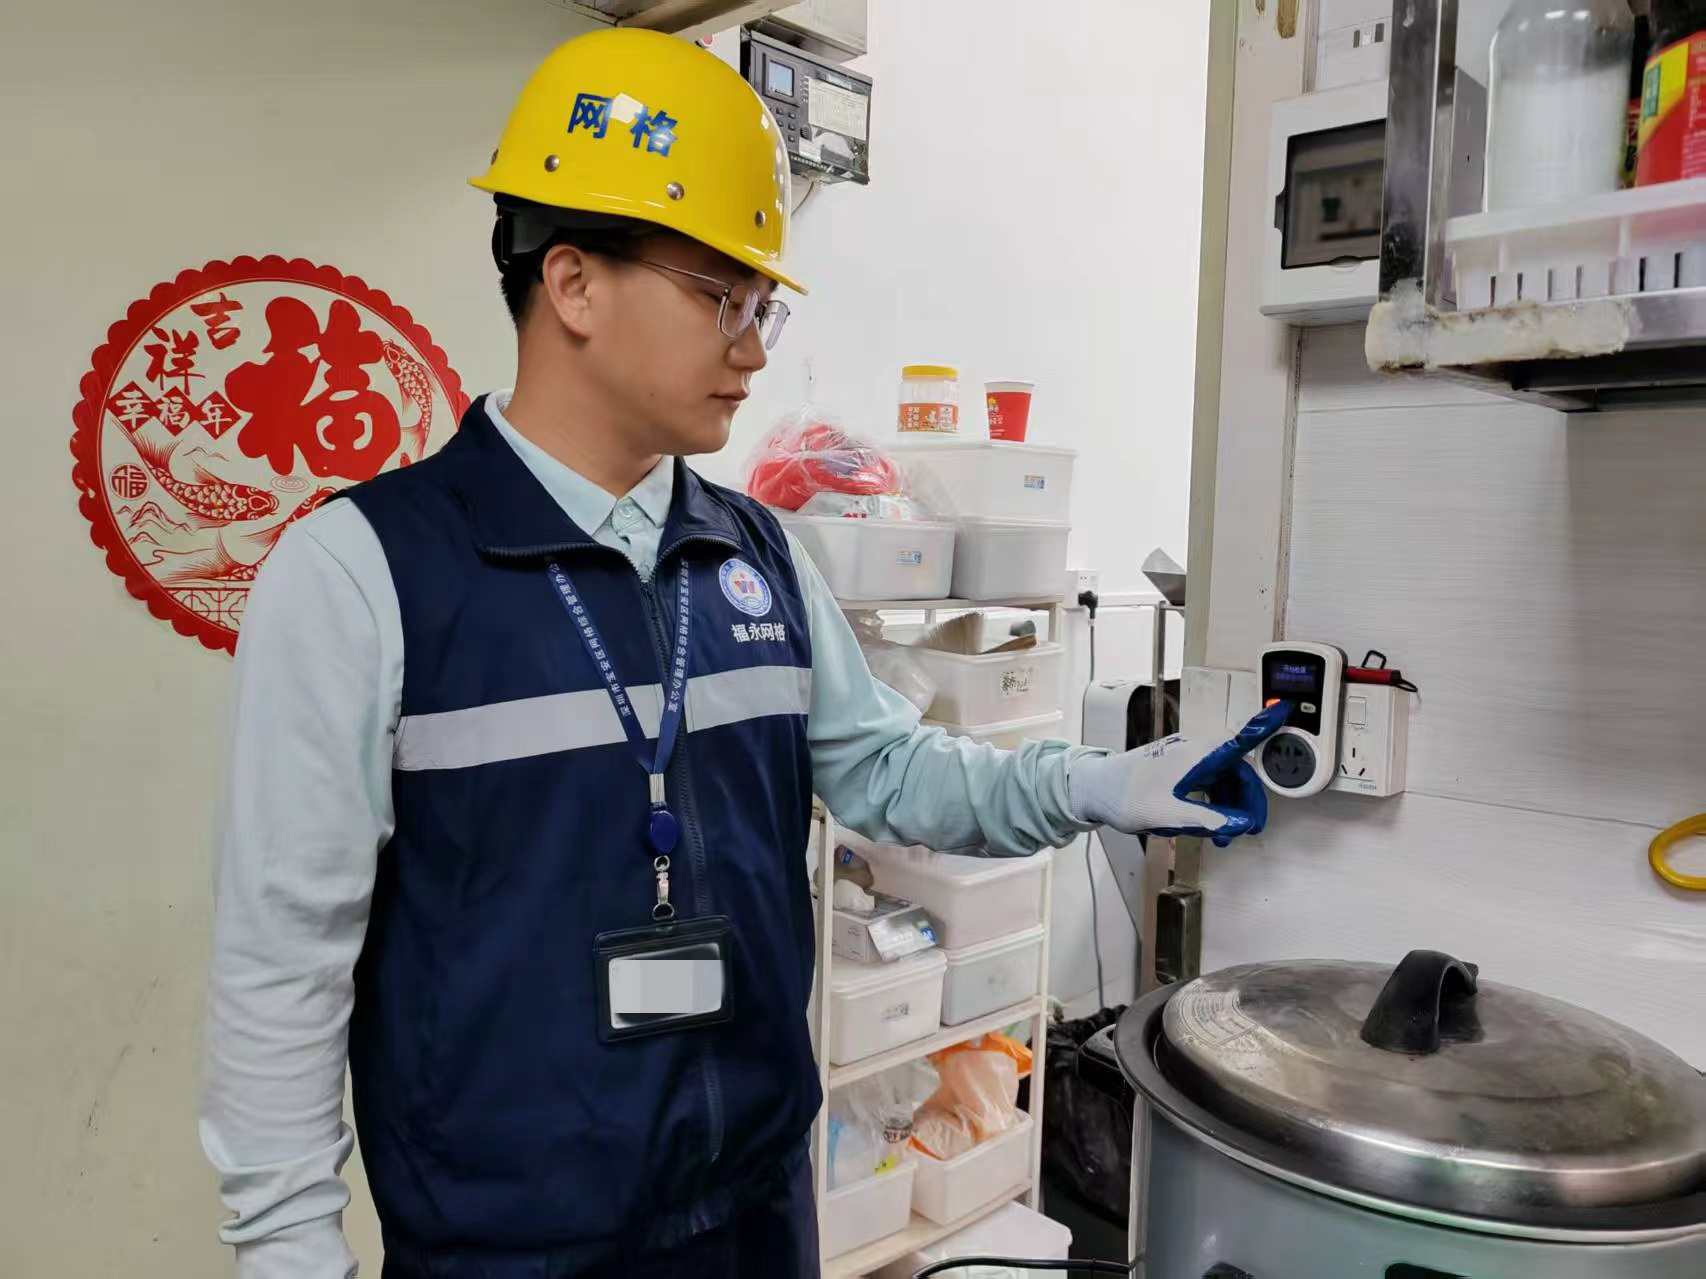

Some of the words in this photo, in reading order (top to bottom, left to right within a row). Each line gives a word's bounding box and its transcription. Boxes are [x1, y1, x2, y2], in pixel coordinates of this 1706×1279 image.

[567, 93, 678, 157] 网格
[118, 389, 233, 435] 幸福年
[225, 297, 401, 481] 福
[731, 622, 786, 643] 福永网格
